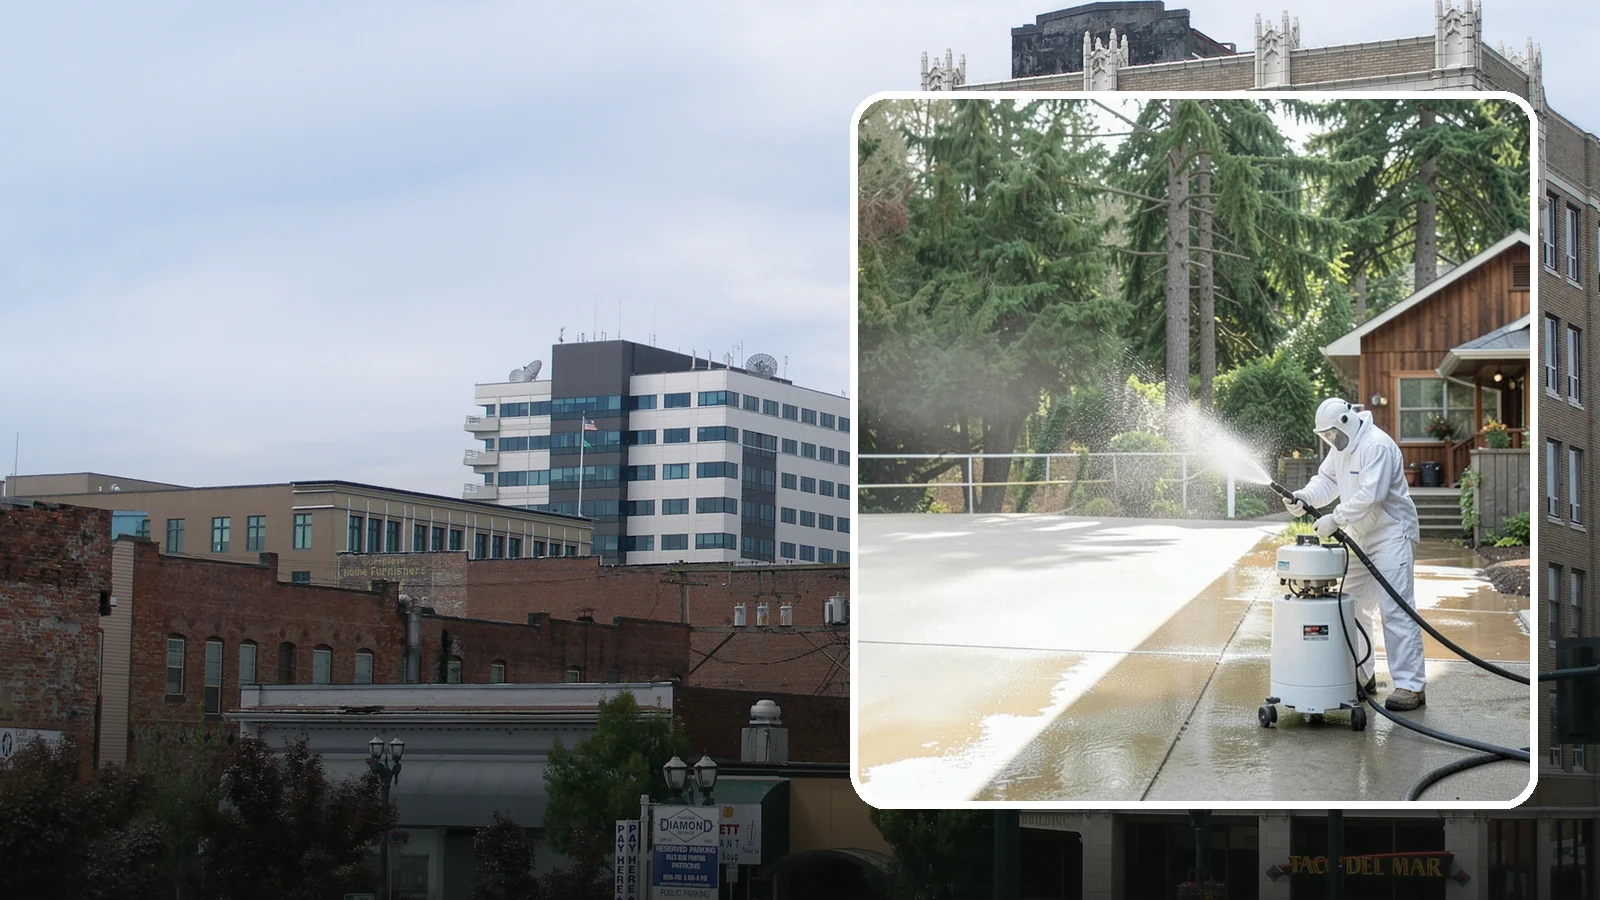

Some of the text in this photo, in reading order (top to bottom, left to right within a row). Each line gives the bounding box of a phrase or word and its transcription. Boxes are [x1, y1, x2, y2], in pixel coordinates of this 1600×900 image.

[370, 566, 427, 577] Furnishers
[660, 818, 713, 833] DIAMOND
[1022, 815, 1070, 828] BUILDING
[616, 825, 625, 893] PAY HERE
[627, 824, 637, 893] PAY HERE
[721, 852, 739, 862] Soup
[672, 862, 700, 870] PATRONS
[1346, 856, 1384, 876] DEL
[1392, 857, 1443, 877] MAR
[660, 889, 710, 898] PUBLIC PARKING
